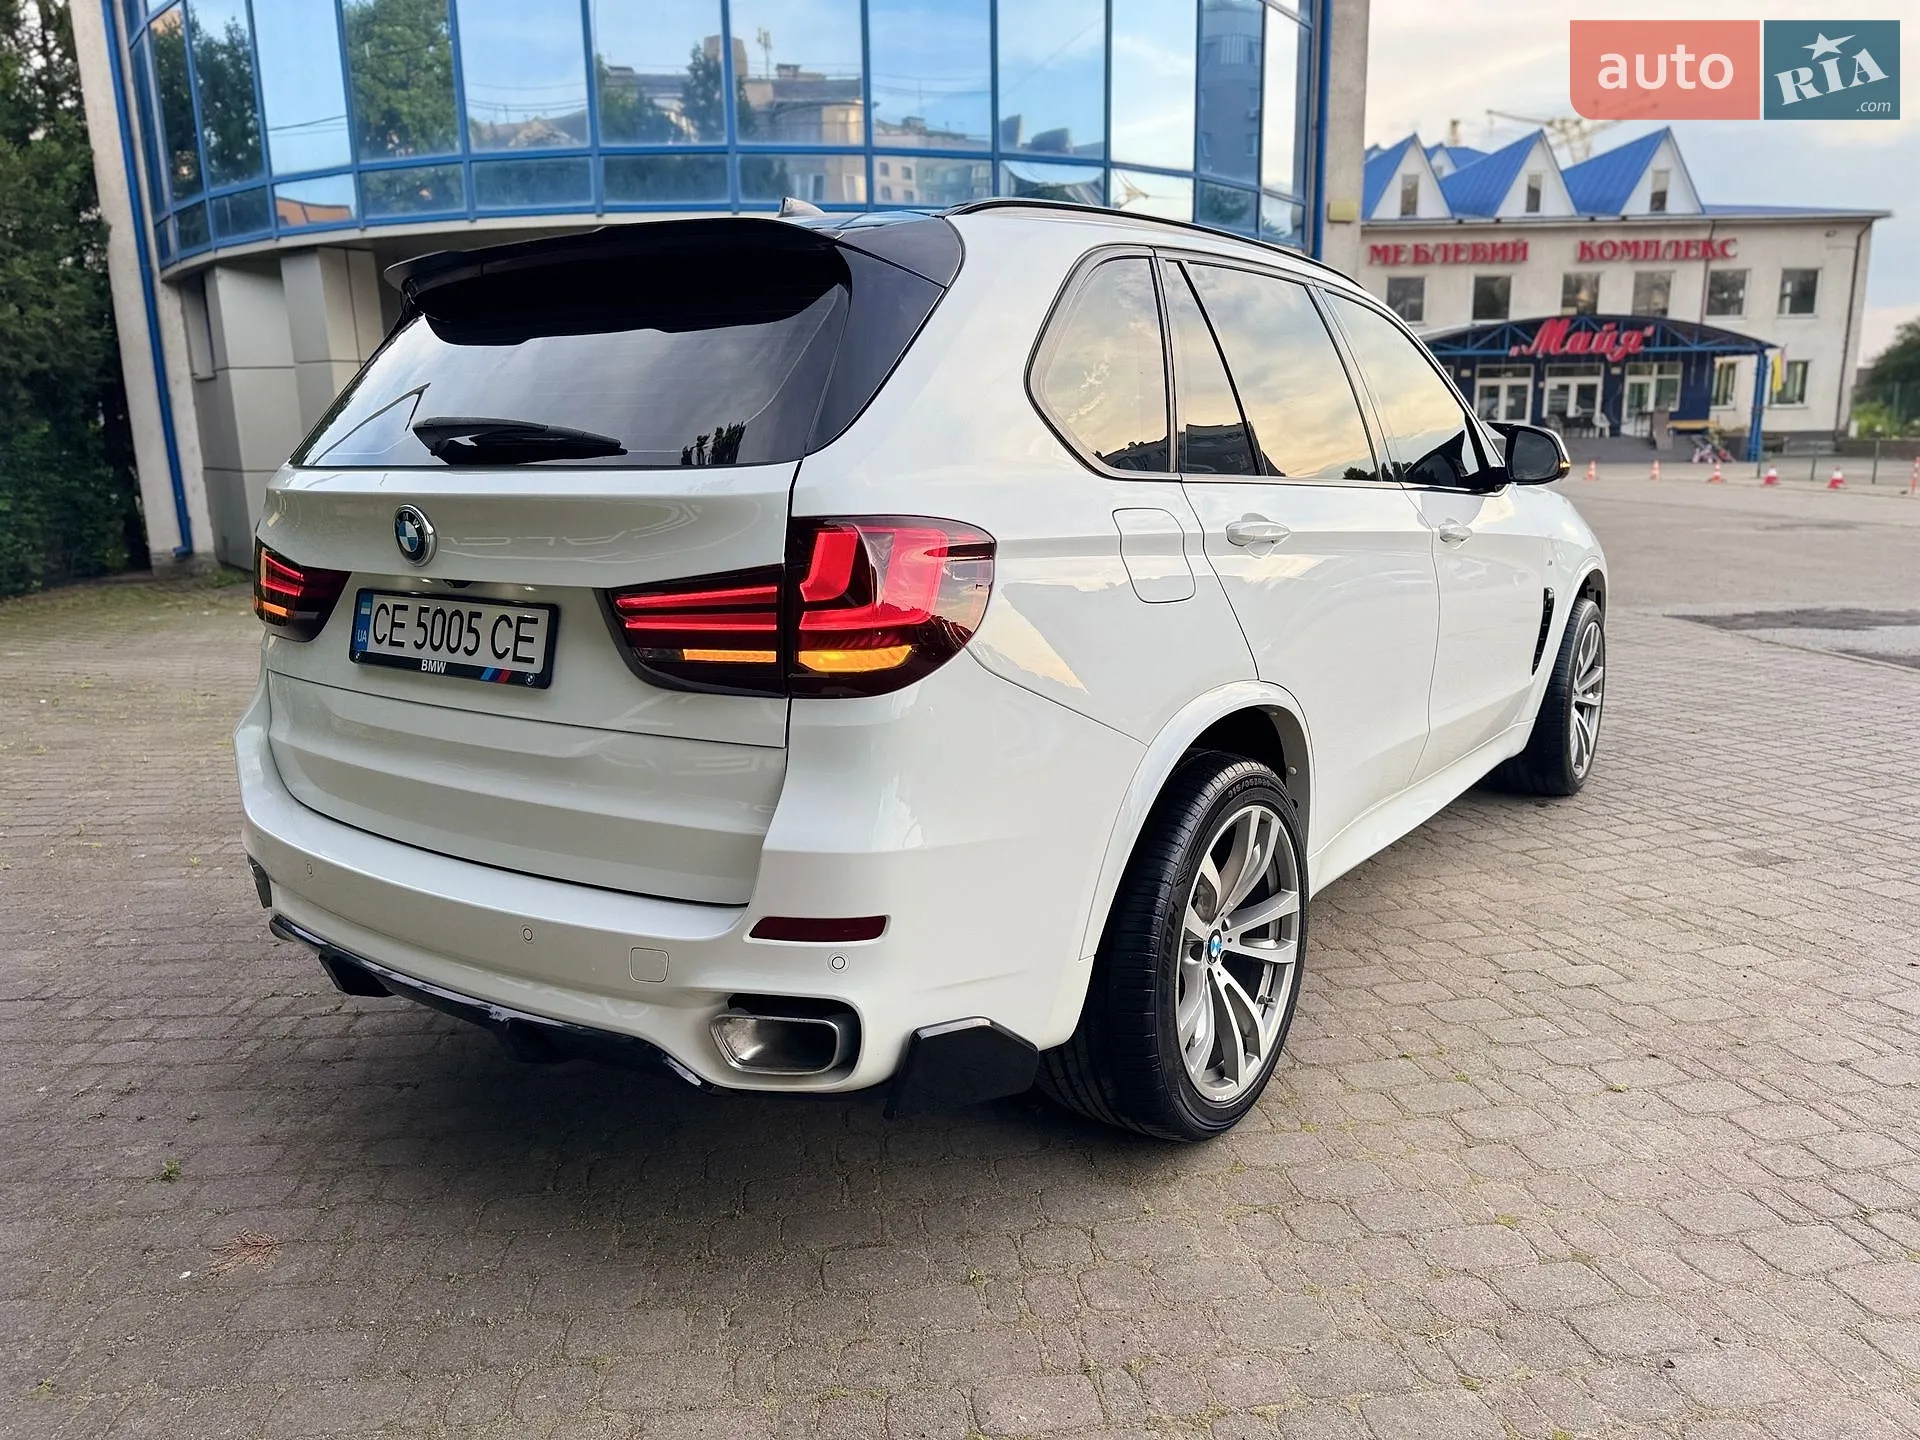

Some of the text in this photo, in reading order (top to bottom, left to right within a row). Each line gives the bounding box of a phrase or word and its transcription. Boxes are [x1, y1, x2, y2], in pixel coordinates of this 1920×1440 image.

[1367, 237, 1739, 266] МЕБЛЕВИЙ КОМПЛЕКС
[357, 629, 368, 643] UA
[372, 603, 539, 664] CE 5005 CE
[420, 659, 447, 674] BMW
